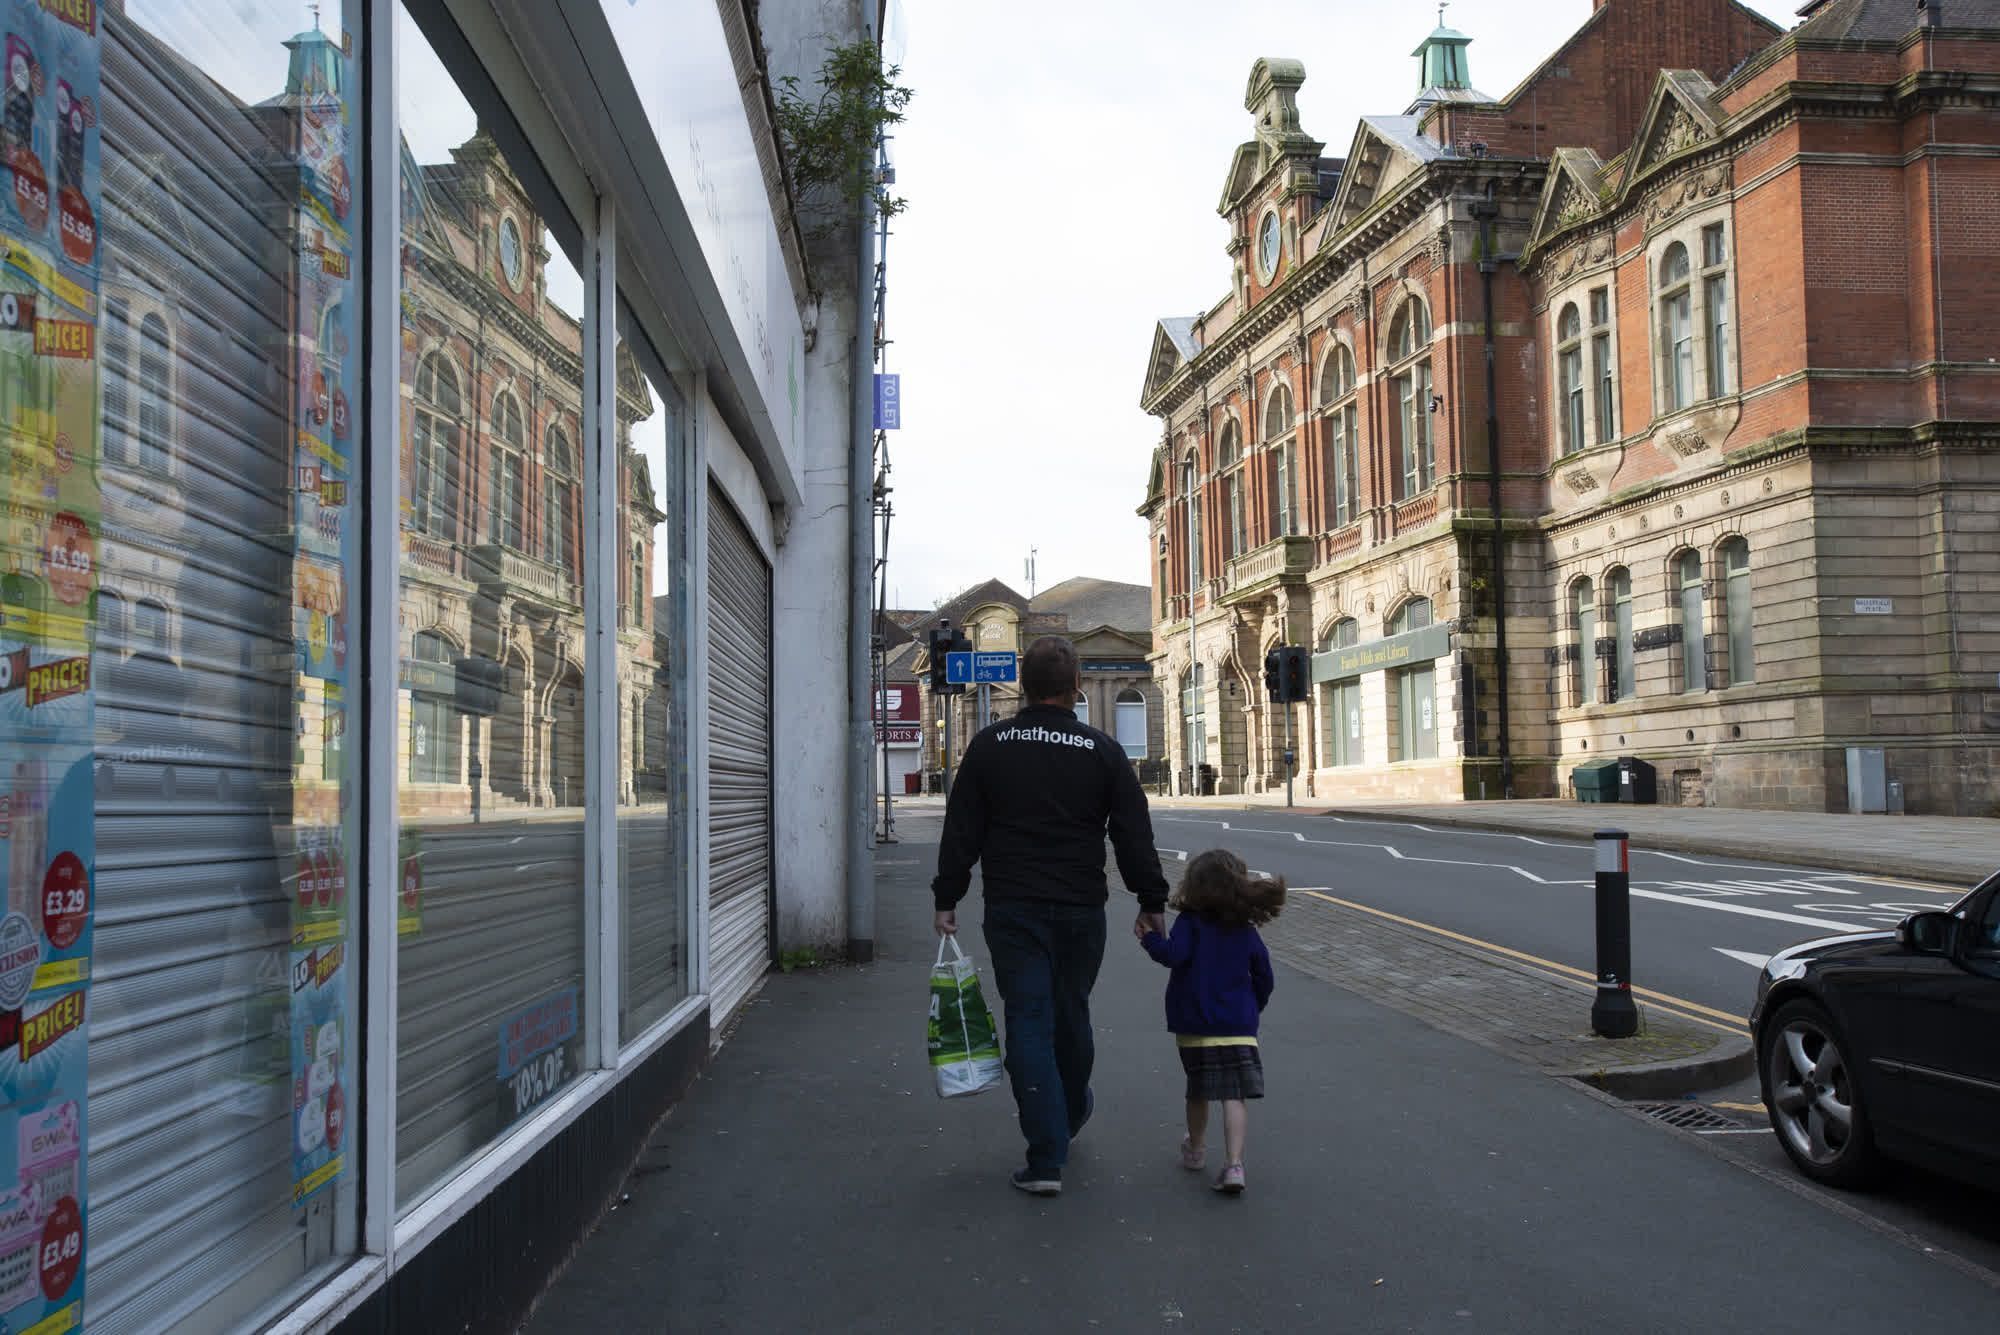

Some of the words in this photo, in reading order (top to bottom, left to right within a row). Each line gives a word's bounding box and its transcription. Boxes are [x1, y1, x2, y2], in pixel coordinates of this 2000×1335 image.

[35, 319, 89, 360] PRICE!
[883, 375, 896, 397] TO
[884, 400, 897, 427] LET
[27, 659, 88, 709] PRICE!
[996, 726, 1095, 750] whathouse
[46, 888, 85, 915] £3.29
[22, 992, 81, 1066] PRICE!
[41, 1231, 80, 1271] £3.49
